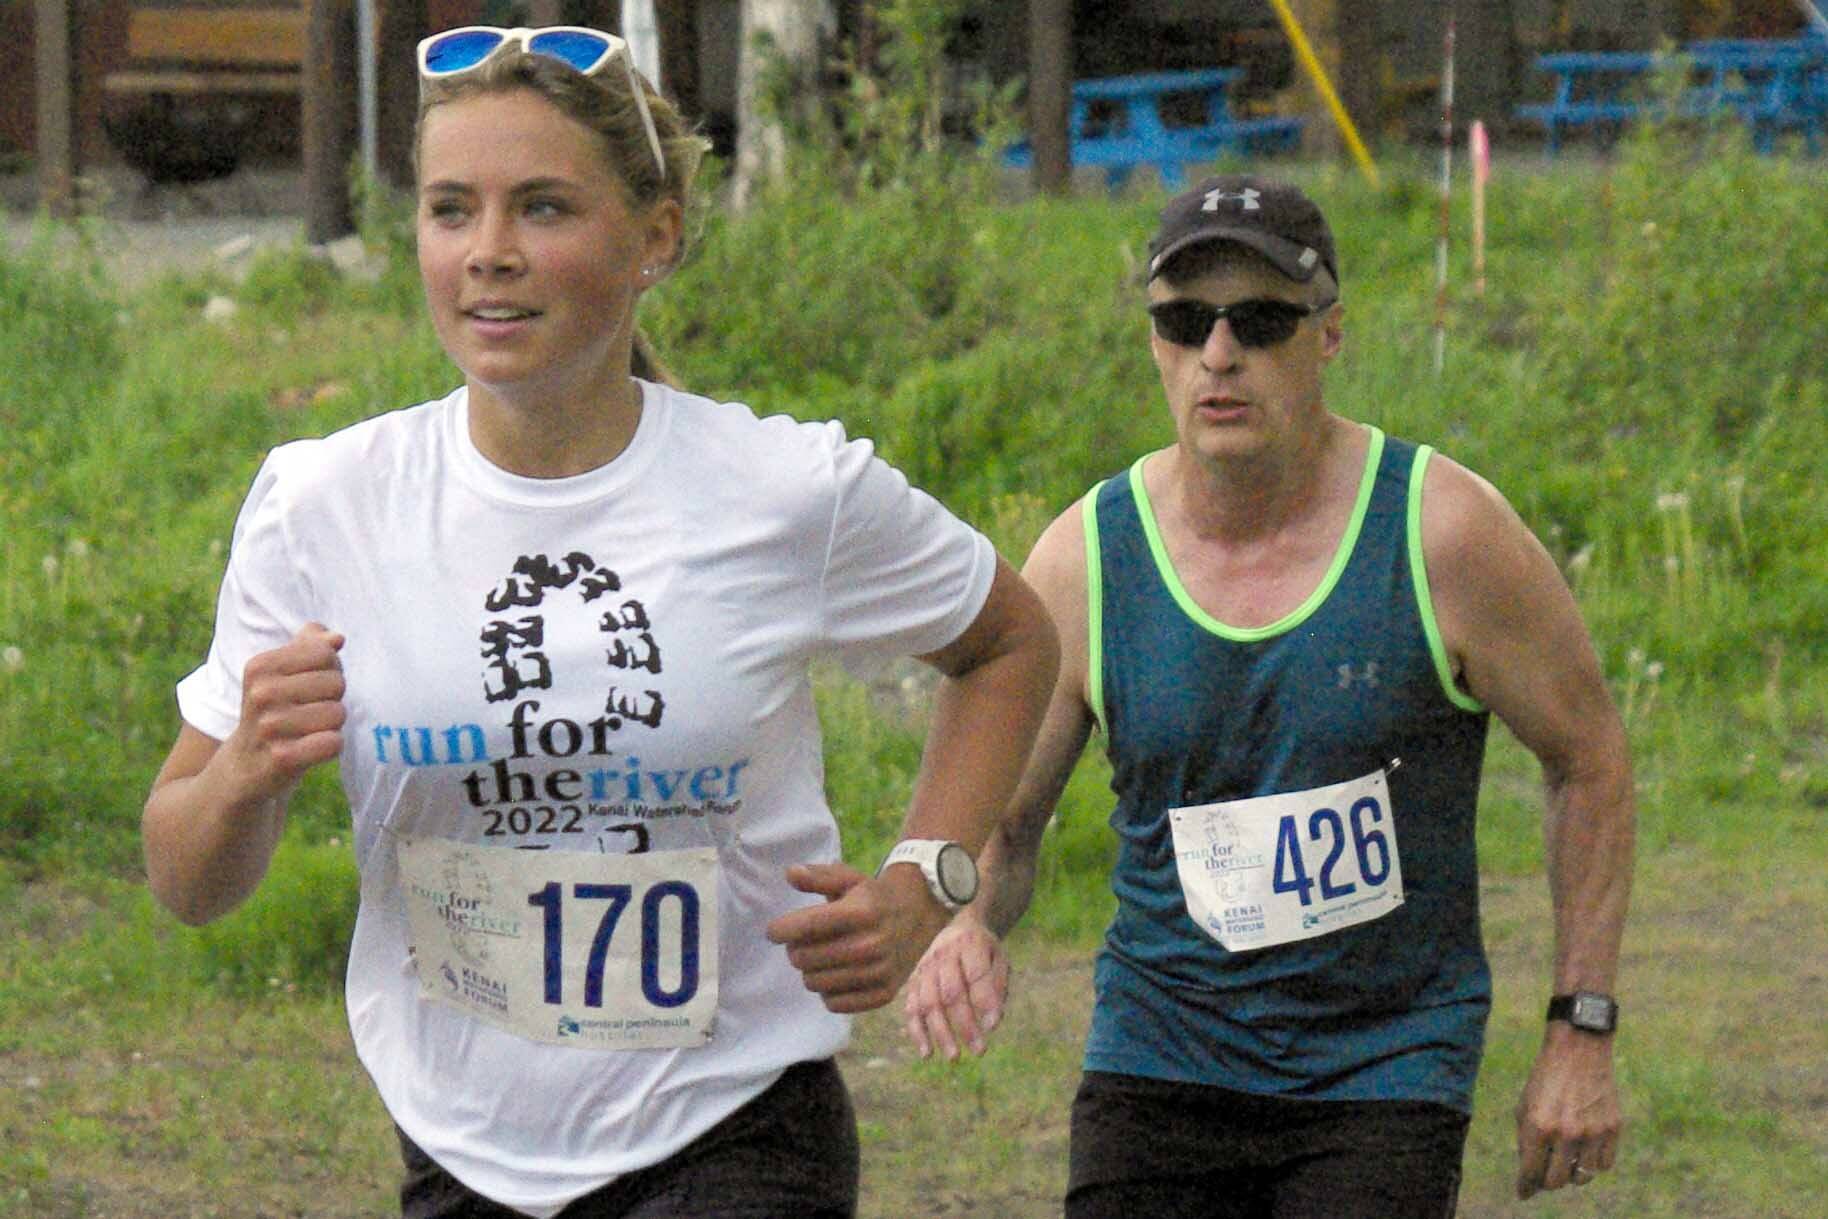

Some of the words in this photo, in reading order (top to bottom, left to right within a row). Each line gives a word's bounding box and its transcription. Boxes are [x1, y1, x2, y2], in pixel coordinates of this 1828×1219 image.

[372, 722, 491, 767] run
[506, 700, 622, 759] for
[483, 805, 584, 836] 2022
[1212, 842, 1233, 857] for
[1273, 796, 1391, 906] 426
[449, 891, 481, 911] for
[1223, 903, 1264, 919] KENAI
[528, 880, 700, 1008] 170
